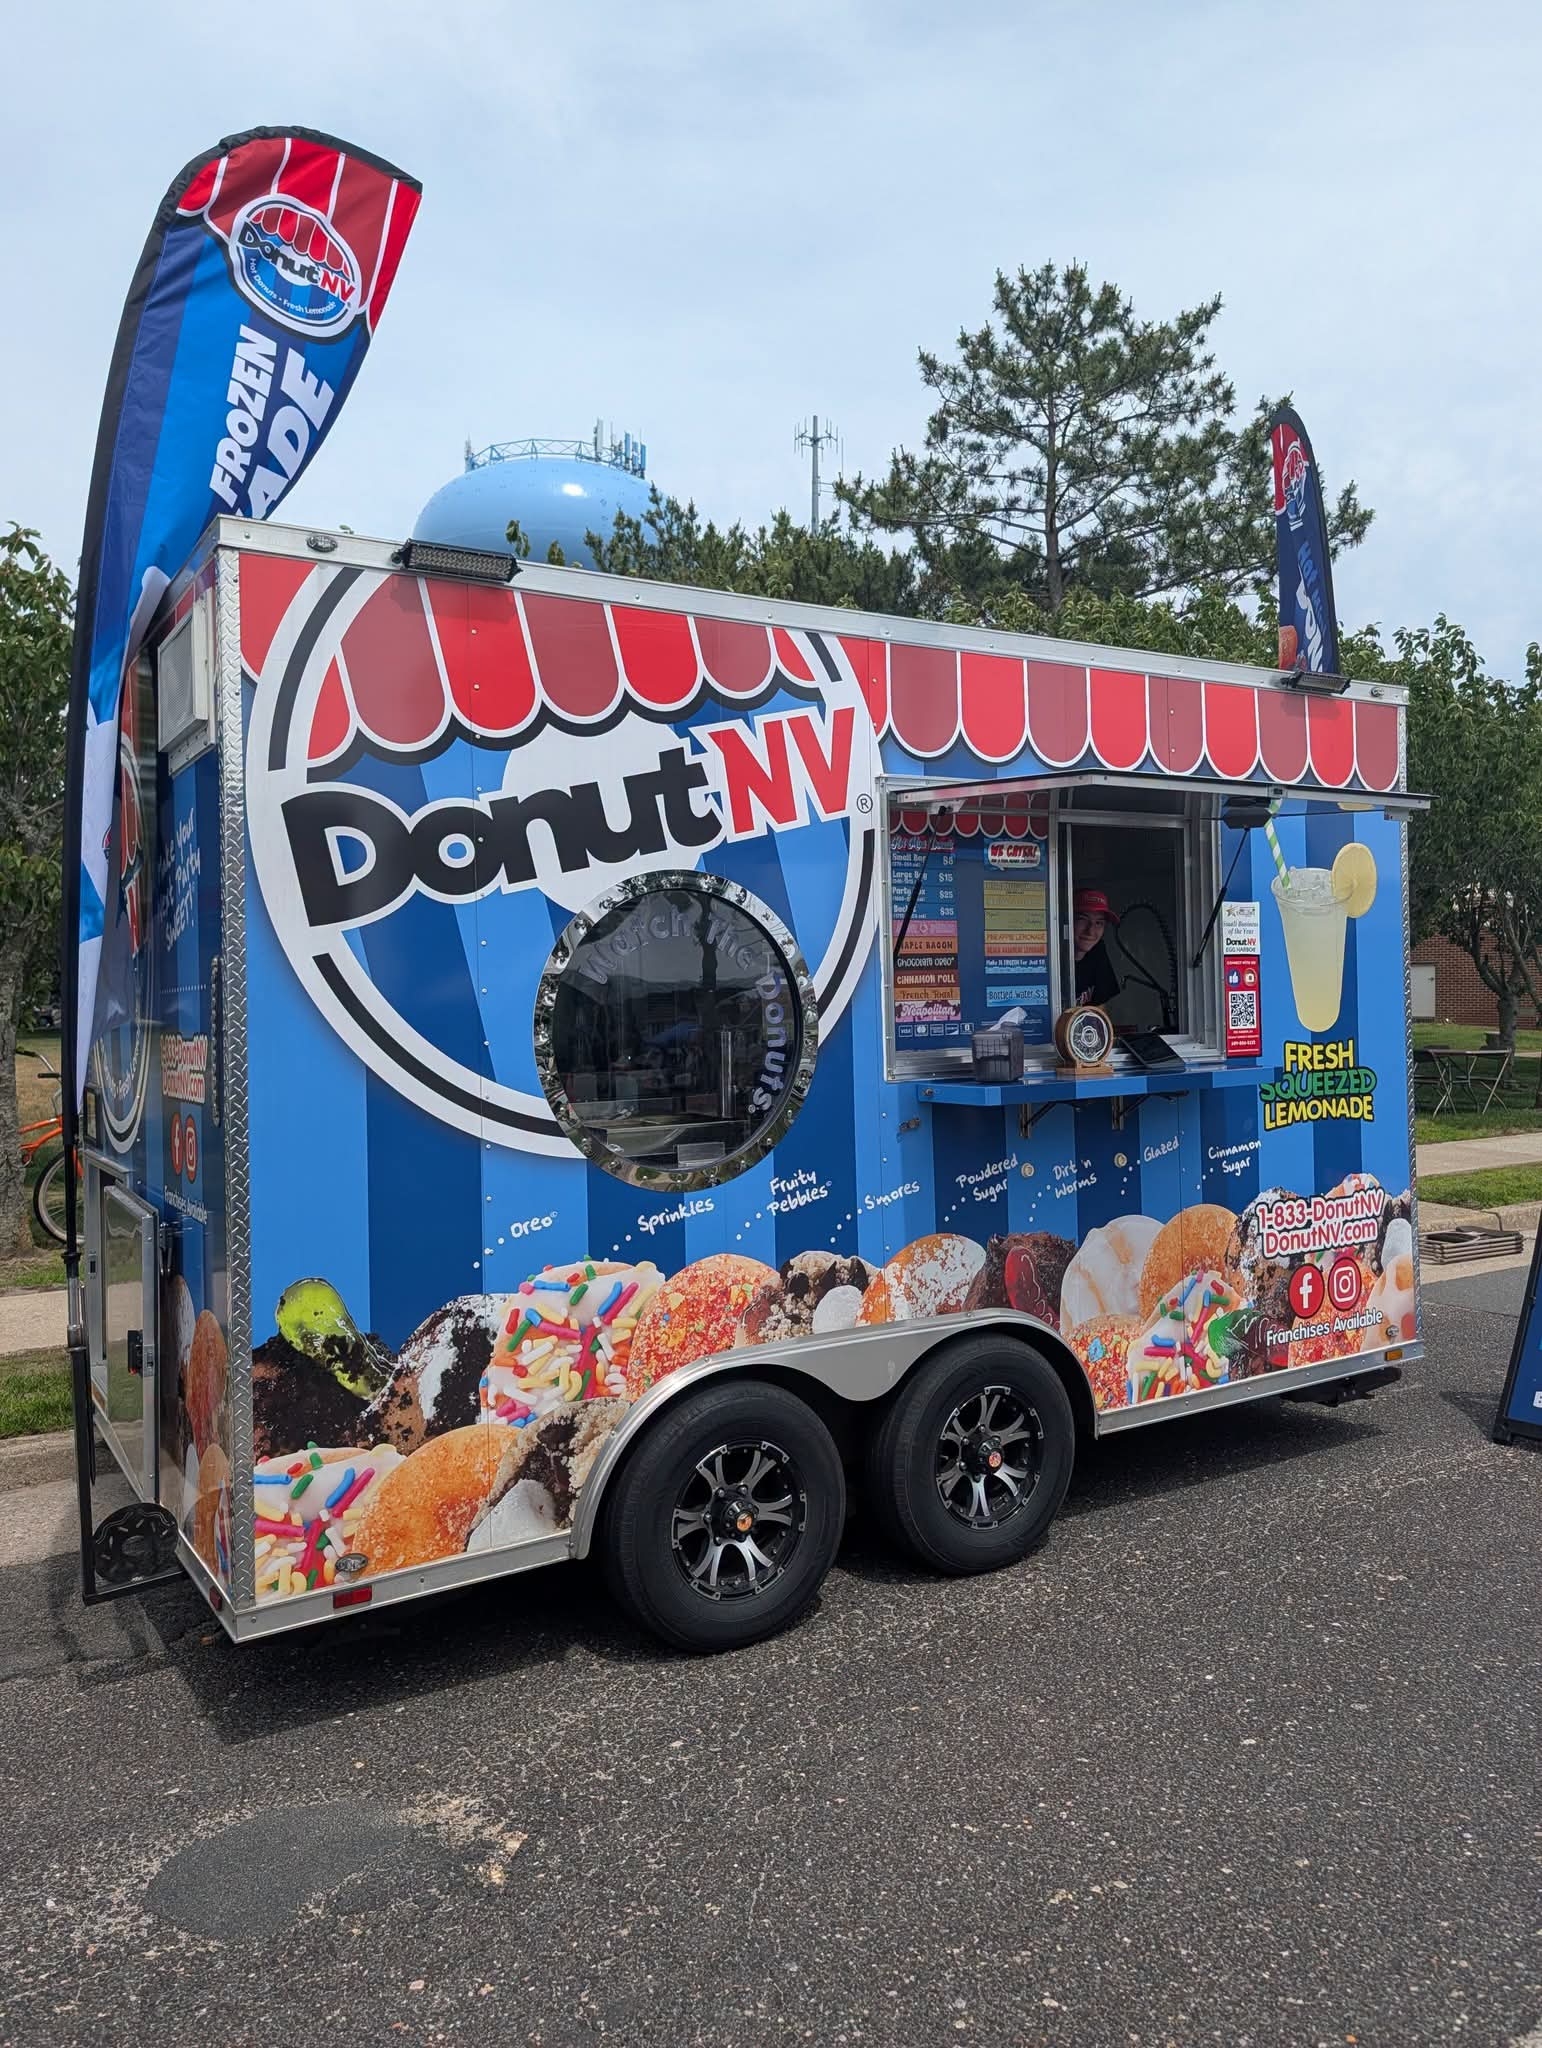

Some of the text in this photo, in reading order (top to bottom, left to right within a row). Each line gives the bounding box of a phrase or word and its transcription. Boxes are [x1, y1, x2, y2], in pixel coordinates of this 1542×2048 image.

[209, 324, 279, 506] FROZEN
[236, 347, 335, 520] ADE
[281, 707, 856, 927] DonutNV
[939, 873, 953, 882] $15
[940, 907, 954, 916] $35
[900, 1002, 956, 1019] Neapolitan
[1284, 1040, 1354, 1073] FRESH
[1260, 1067, 1377, 1101] SQUEEZED
[1264, 1095, 1374, 1131] LEMONADE
[1143, 1136, 1180, 1162] Glazed
[1208, 1139, 1262, 1160] Cinnamon
[769, 1169, 817, 1196] Fruity
[955, 1153, 1019, 1189] Powdered
[1052, 1162, 1078, 1181] Dirt
[1222, 1157, 1251, 1176] Sugar
[972, 1178, 1009, 1204] Sugar
[1055, 1174, 1098, 1199] Worms
[637, 1198, 715, 1233] Sprinkles
[1257, 1190, 1384, 1230] 1-833-DonutNV
[1264, 1219, 1377, 1254] DonutNV.com
[1266, 1308, 1383, 1347] Franchises Available
